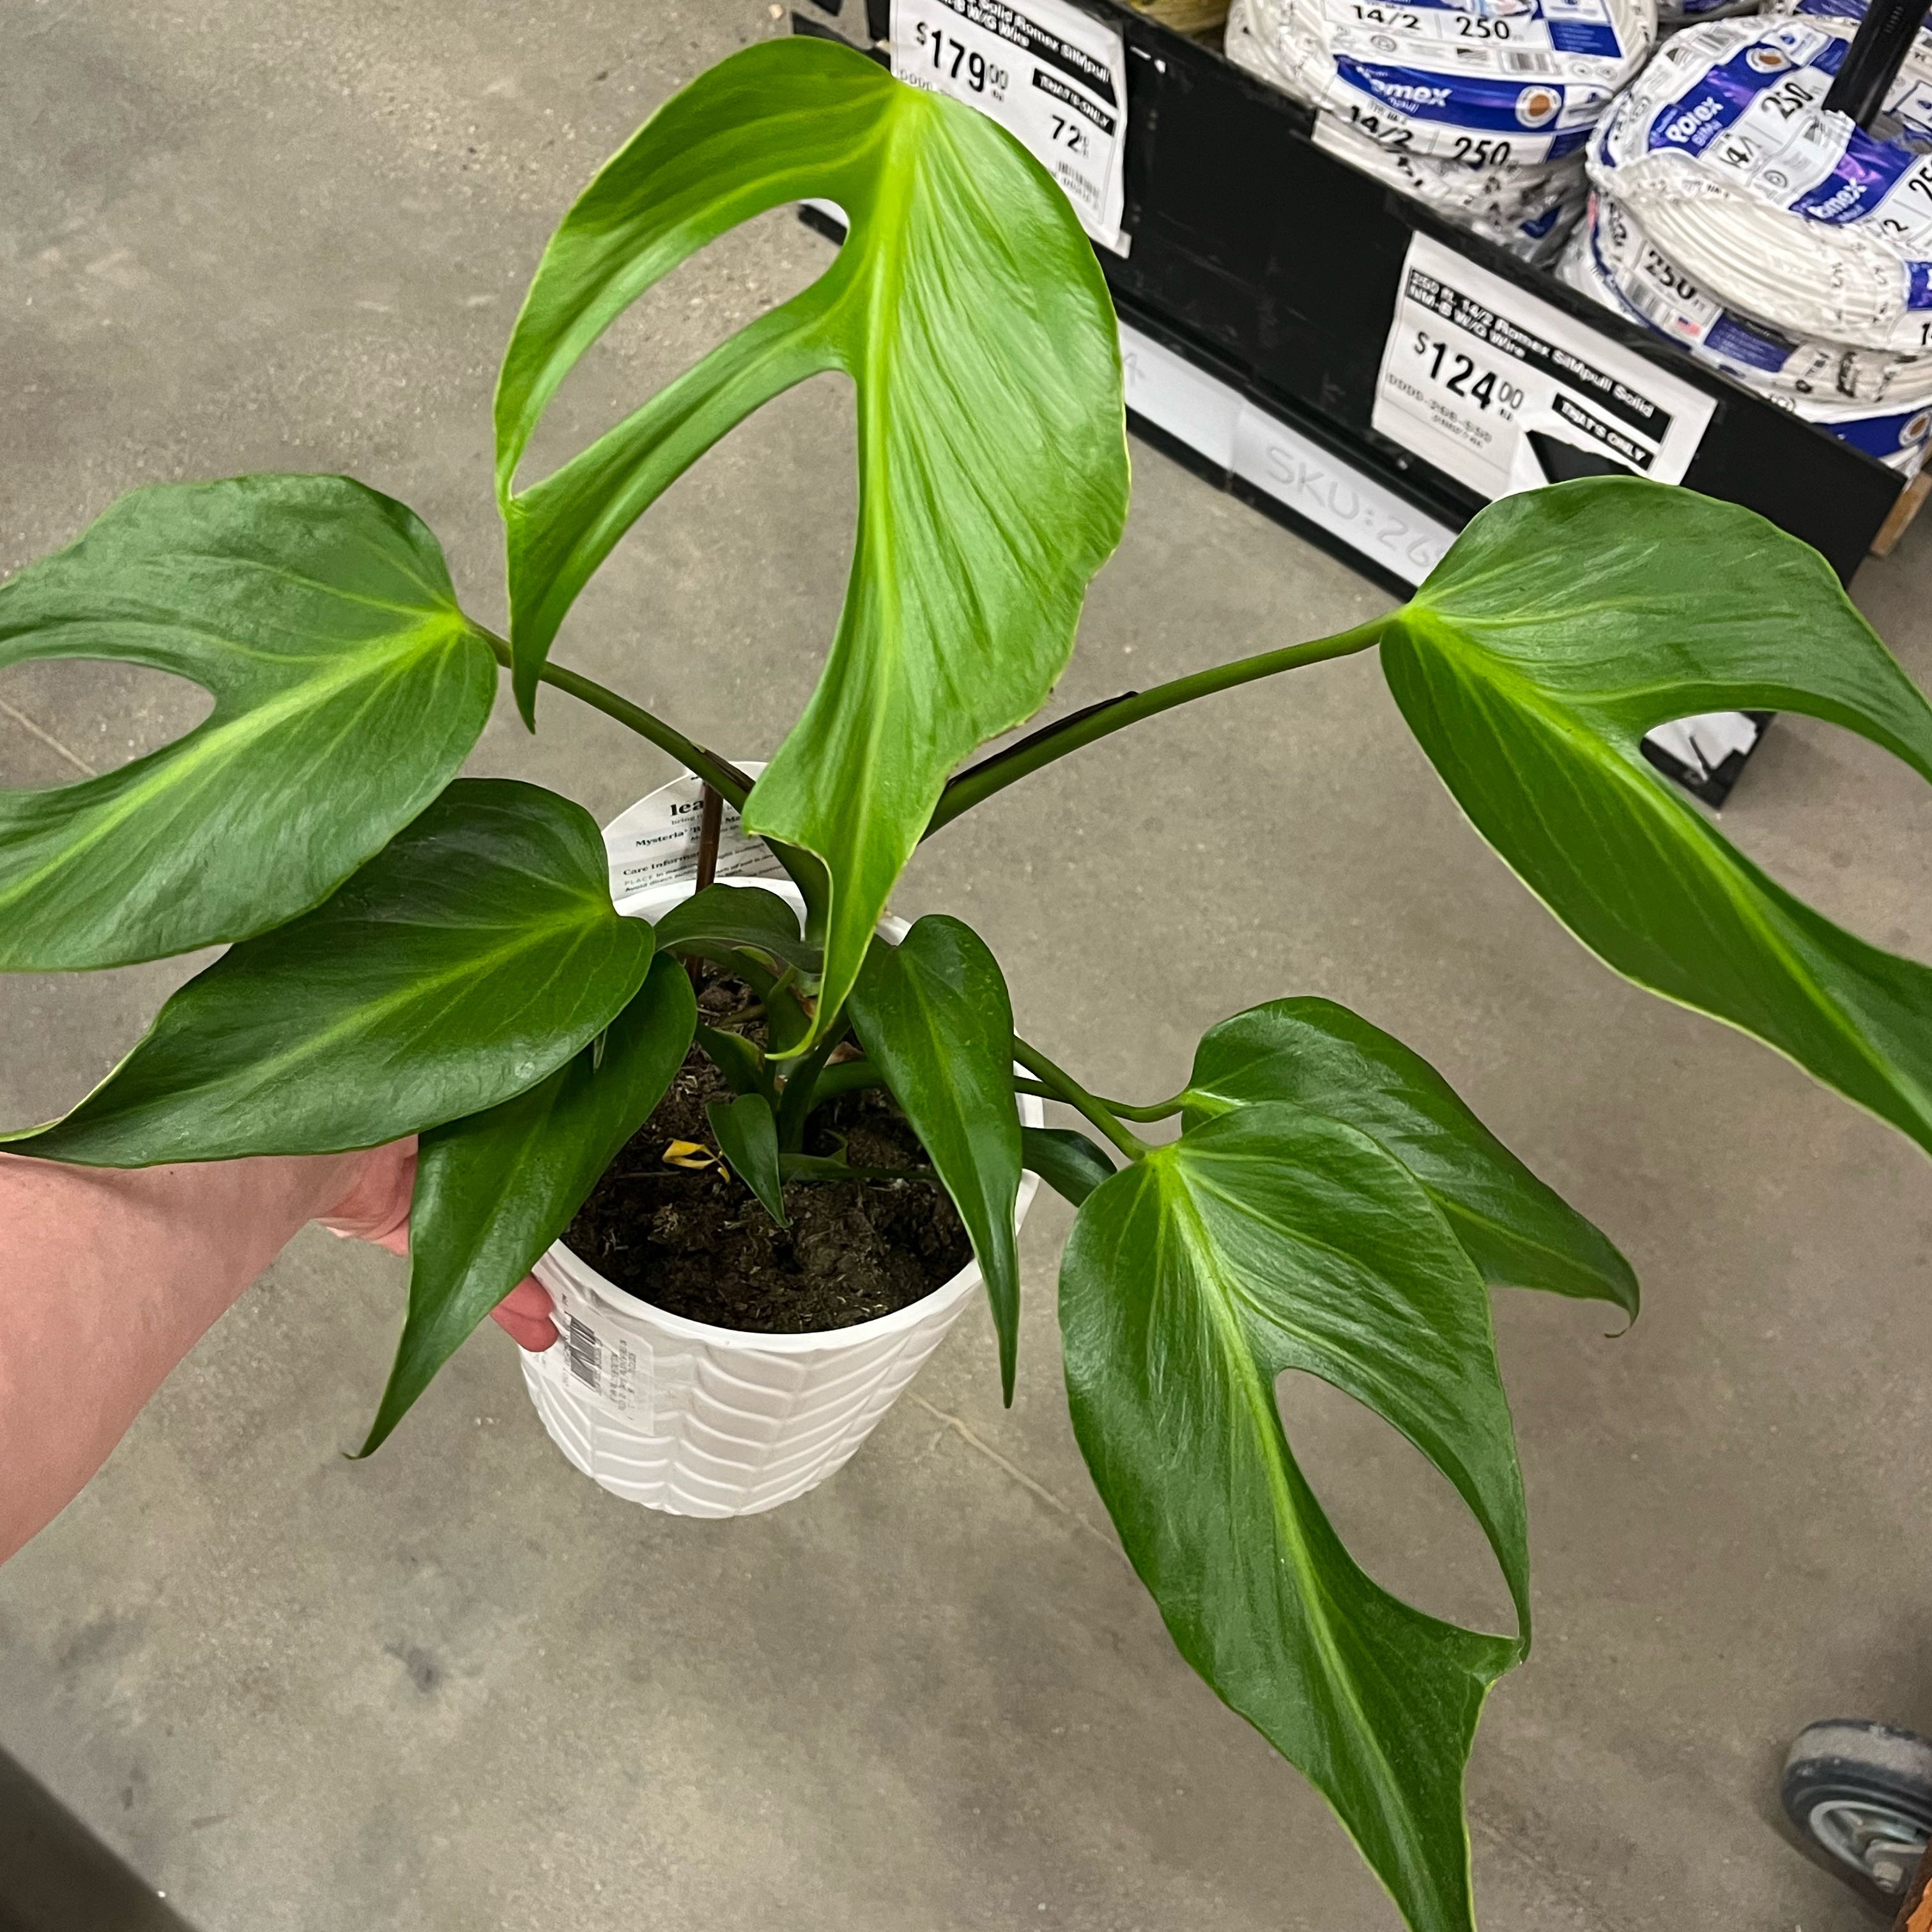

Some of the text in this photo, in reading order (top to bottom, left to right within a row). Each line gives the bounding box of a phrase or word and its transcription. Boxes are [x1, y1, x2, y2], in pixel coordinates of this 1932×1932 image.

[1351, 4, 1422, 30] 14/2
[1455, 15, 1510, 40] 250
[1761, 82, 1814, 119] 250
[1351, 105, 1414, 146] 14/2
[1454, 137, 1511, 169] 250
[1646, 250, 1696, 300] 250
[670, 800, 704, 816] lea
[623, 866, 648, 875] Care
